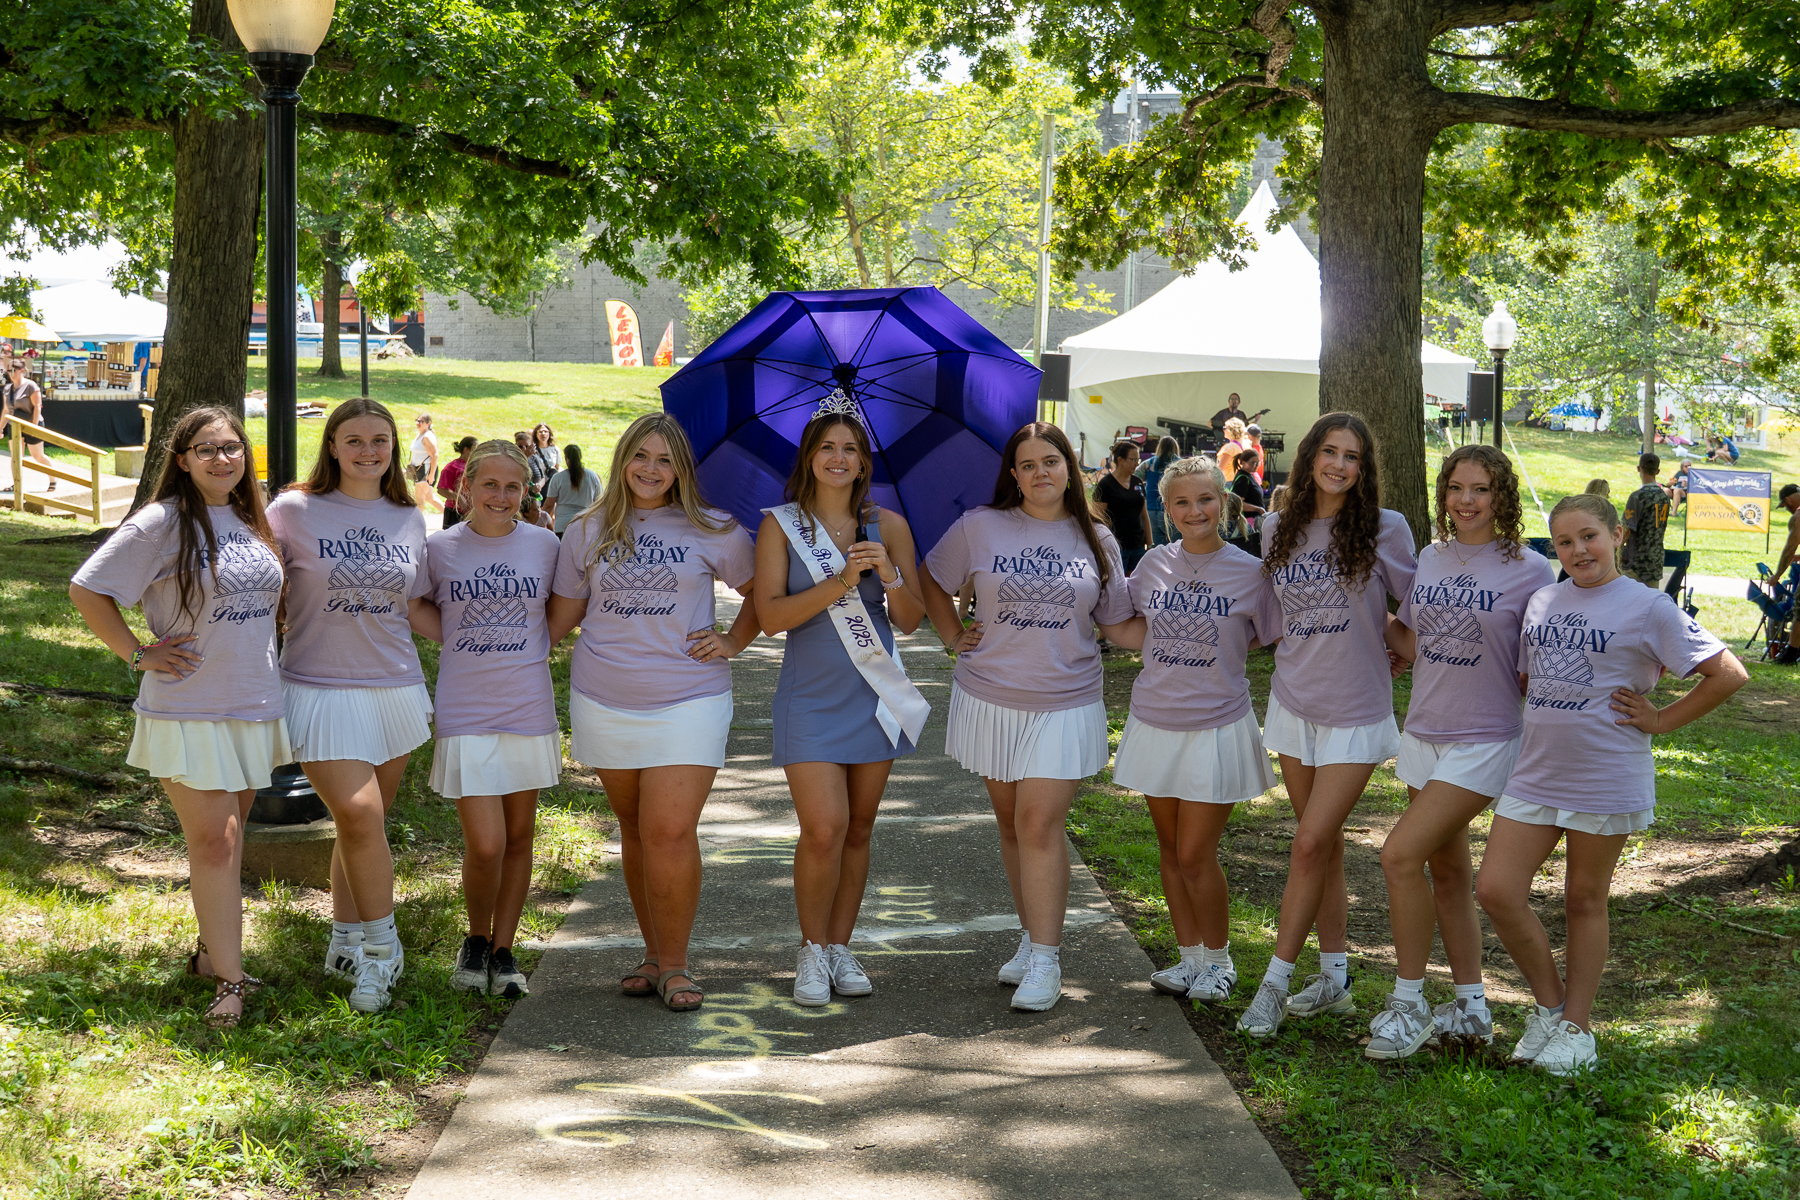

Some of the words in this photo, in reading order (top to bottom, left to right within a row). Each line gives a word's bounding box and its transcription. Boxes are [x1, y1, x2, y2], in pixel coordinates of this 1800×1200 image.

[1693, 511, 1737, 519] SPONSOR
[217, 531, 252, 546] Miss
[344, 526, 385, 543] Miss
[243, 545, 279, 563] DA
[317, 538, 370, 562] RAIN
[374, 543, 411, 564] DAY
[648, 546, 690, 565] DAY
[792, 520, 817, 548] Miss
[811, 548, 835, 579] Rain
[1021, 545, 1062, 561] Miss
[474, 562, 517, 578] Miss
[991, 555, 1043, 577] RAIN
[1046, 561, 1087, 579] DAY
[1272, 562, 1315, 587] RAIN
[450, 578, 499, 602] RAIN
[502, 577, 541, 599] DAY
[1174, 581, 1214, 595] Miss
[1439, 573, 1479, 588] Miss
[323, 598, 396, 618] Pageant
[600, 599, 677, 619] Pageant
[1148, 590, 1194, 613] RAIN
[1193, 594, 1238, 618] DAY
[1411, 584, 1458, 607] RAIN
[1454, 588, 1504, 613] DAY
[208, 604, 274, 625] Pageant
[994, 610, 1072, 631] Pageant
[1547, 611, 1589, 627] Miss
[845, 615, 875, 648] 2025
[1286, 620, 1351, 641] Pageant
[1523, 624, 1568, 649] RAIN
[1565, 627, 1617, 654] DAY
[452, 637, 528, 657] Pageant
[1152, 647, 1218, 668] Pageant
[1526, 687, 1591, 710] Pageant
